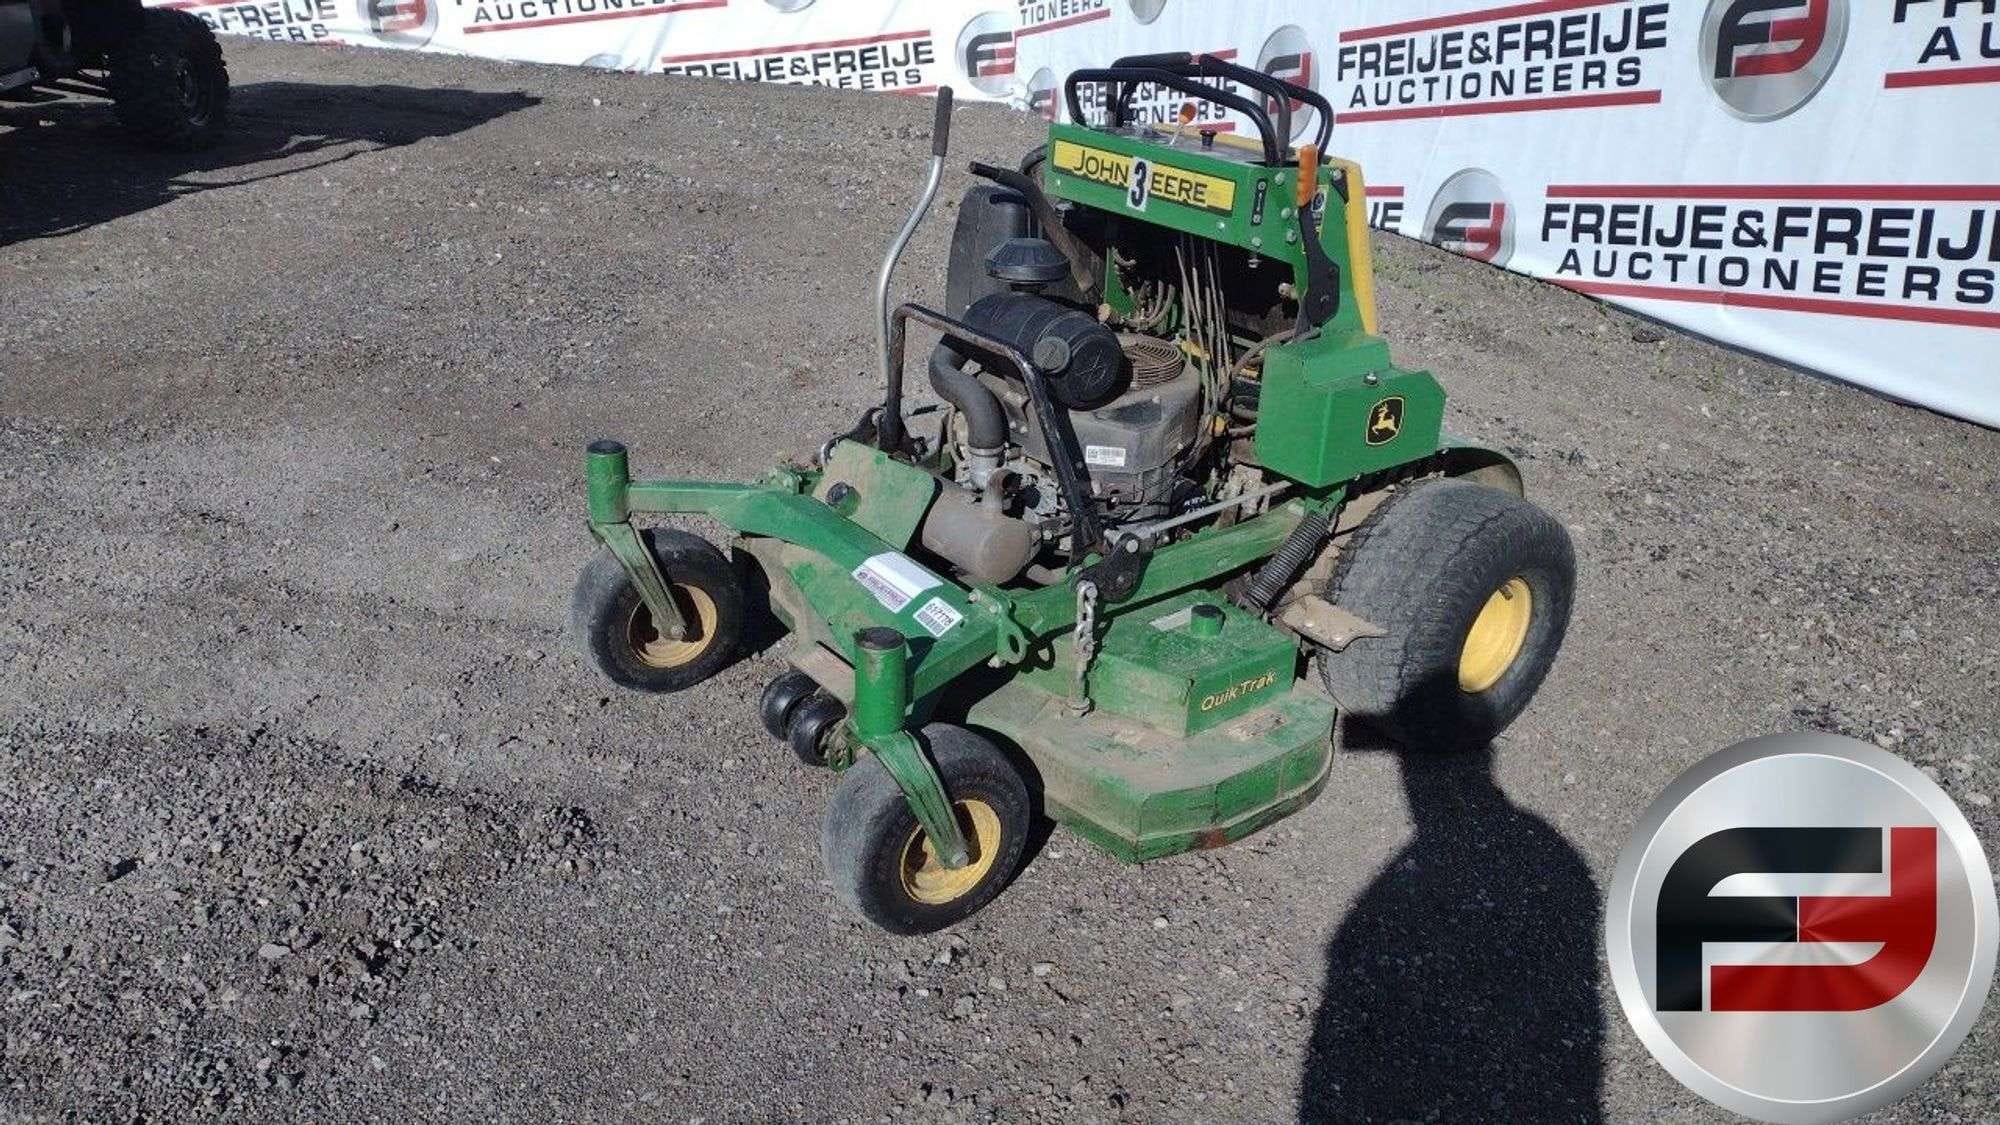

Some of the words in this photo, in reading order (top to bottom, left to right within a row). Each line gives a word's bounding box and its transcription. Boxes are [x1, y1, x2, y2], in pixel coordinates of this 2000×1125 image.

[1337, 3, 1670, 81] FREIJE&FREIJE
[1350, 57, 1642, 108] AUCTIONEERS
[1073, 150, 1130, 183] JOHN
[1151, 172, 1207, 203] EERE
[1130, 160, 1148, 208] 3
[1556, 248, 1995, 304] AUCTIONEERS
